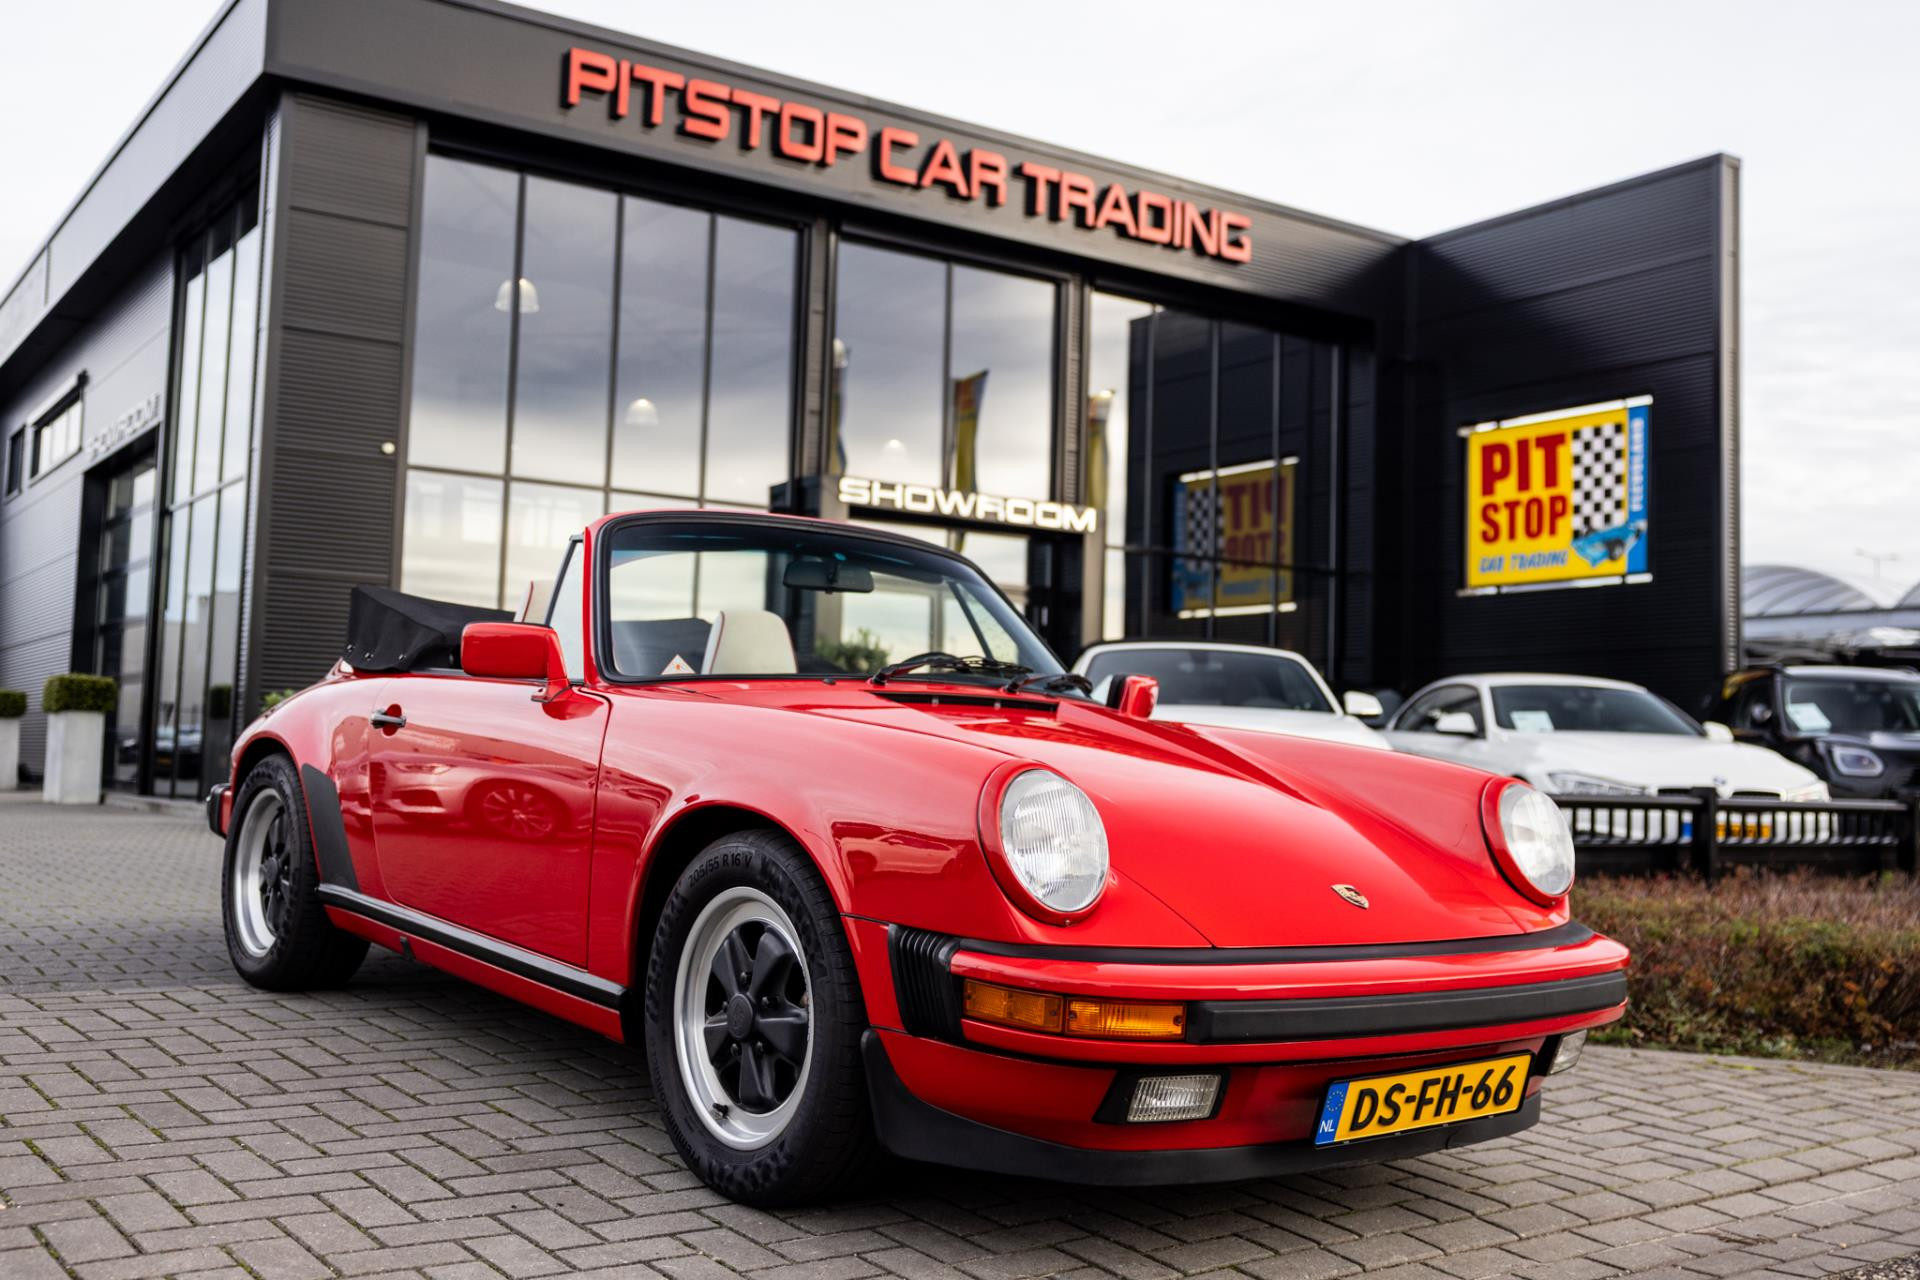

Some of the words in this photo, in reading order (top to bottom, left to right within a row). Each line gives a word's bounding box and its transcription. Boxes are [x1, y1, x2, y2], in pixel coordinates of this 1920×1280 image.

[563, 47, 868, 167] PITSTOP
[876, 126, 1007, 206] CAR
[1019, 160, 1253, 264] TRADING
[1480, 432, 1566, 497] PIT
[838, 476, 1096, 533] SHOWROOM
[1480, 494, 1567, 544] STOP
[722, 853, 732, 867] R
[1319, 1120, 1335, 1133] NL
[1348, 1065, 1517, 1132] DS-FH-66
